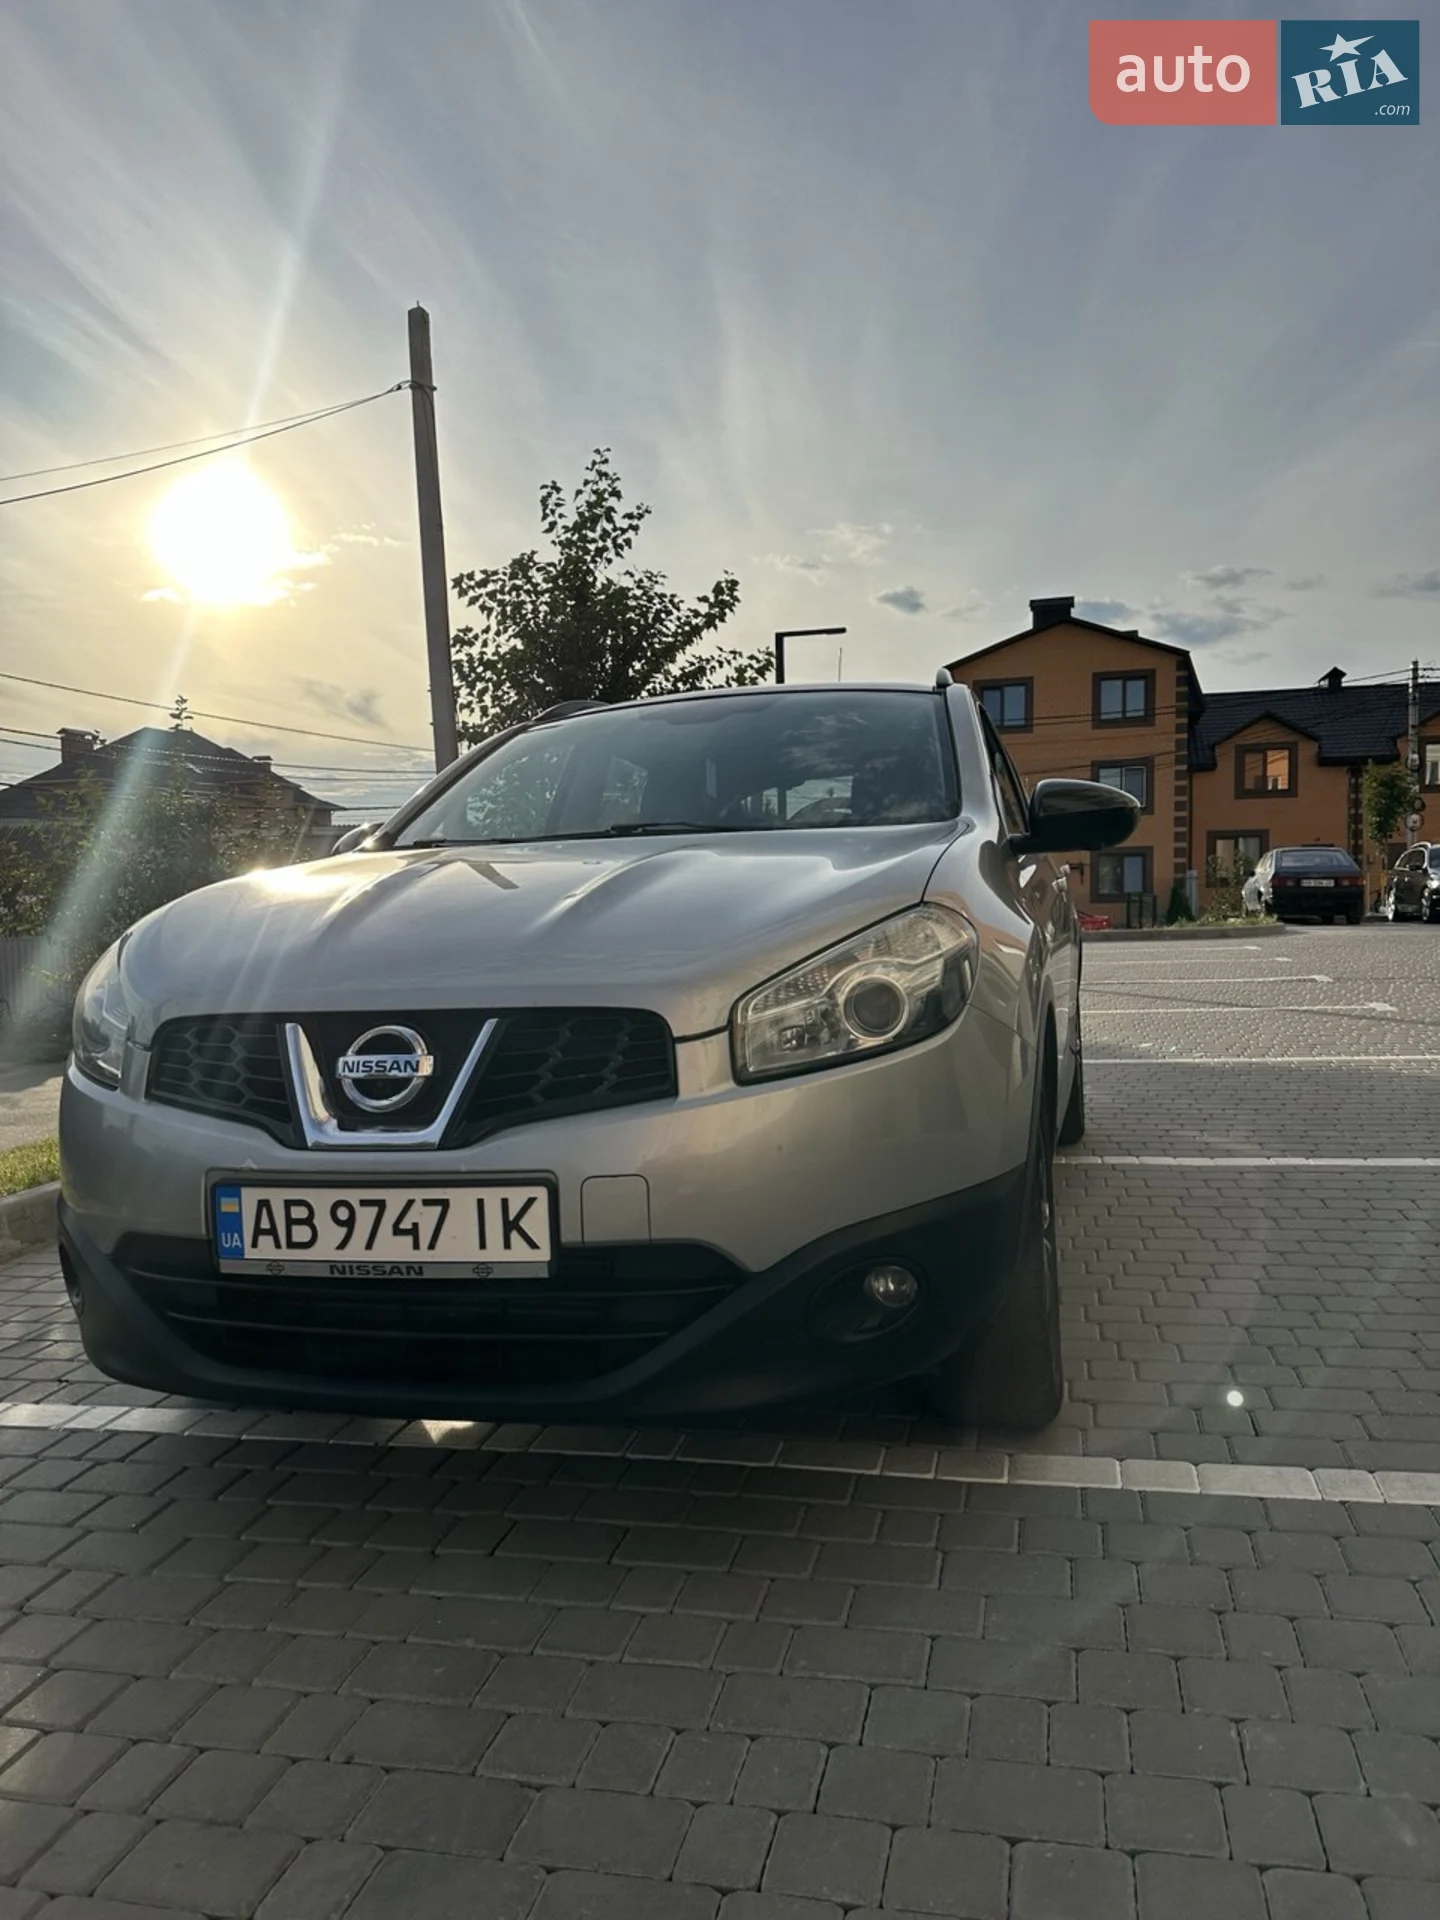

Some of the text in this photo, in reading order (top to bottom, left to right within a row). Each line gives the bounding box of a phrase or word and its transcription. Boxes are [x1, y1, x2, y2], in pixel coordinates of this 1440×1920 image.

[341, 1059, 420, 1074] NISSAN
[251, 1197, 541, 1251] AB 9747 IK
[221, 1232, 242, 1249] UA
[328, 1264, 424, 1277] NISSAN
